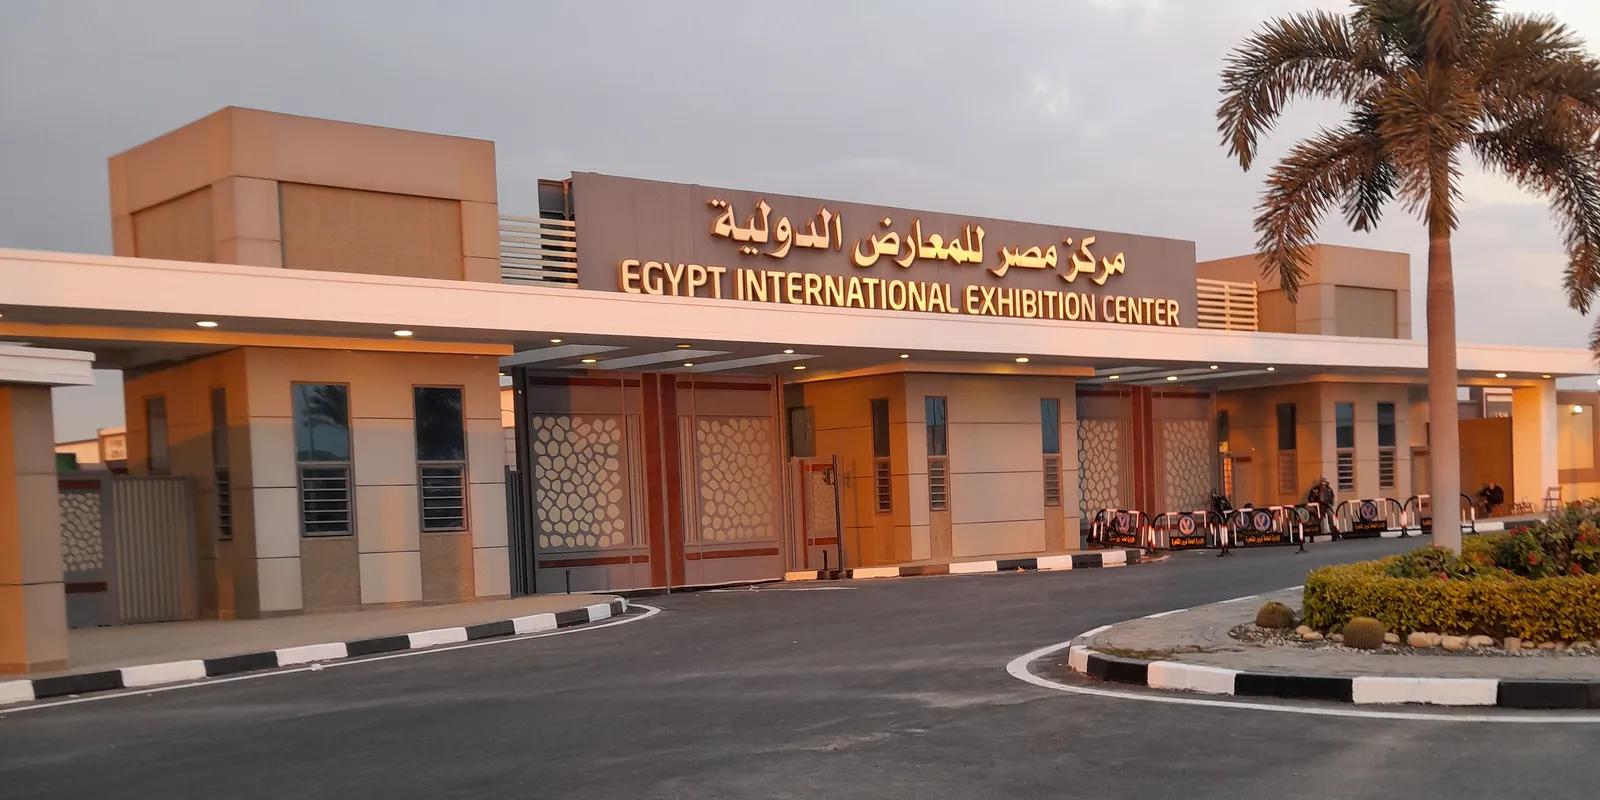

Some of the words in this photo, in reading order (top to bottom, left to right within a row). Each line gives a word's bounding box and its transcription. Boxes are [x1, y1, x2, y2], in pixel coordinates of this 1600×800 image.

[707, 198, 842, 259] الدولية
[853, 217, 985, 269] للمعارض
[987, 243, 1058, 277] مصر
[1058, 235, 1126, 285] مركز
[619, 258, 727, 299] EGYPT
[735, 267, 958, 313] INTERNATIONAL
[964, 284, 1096, 321] EXHIBITION
[1102, 295, 1180, 326] CENTER
